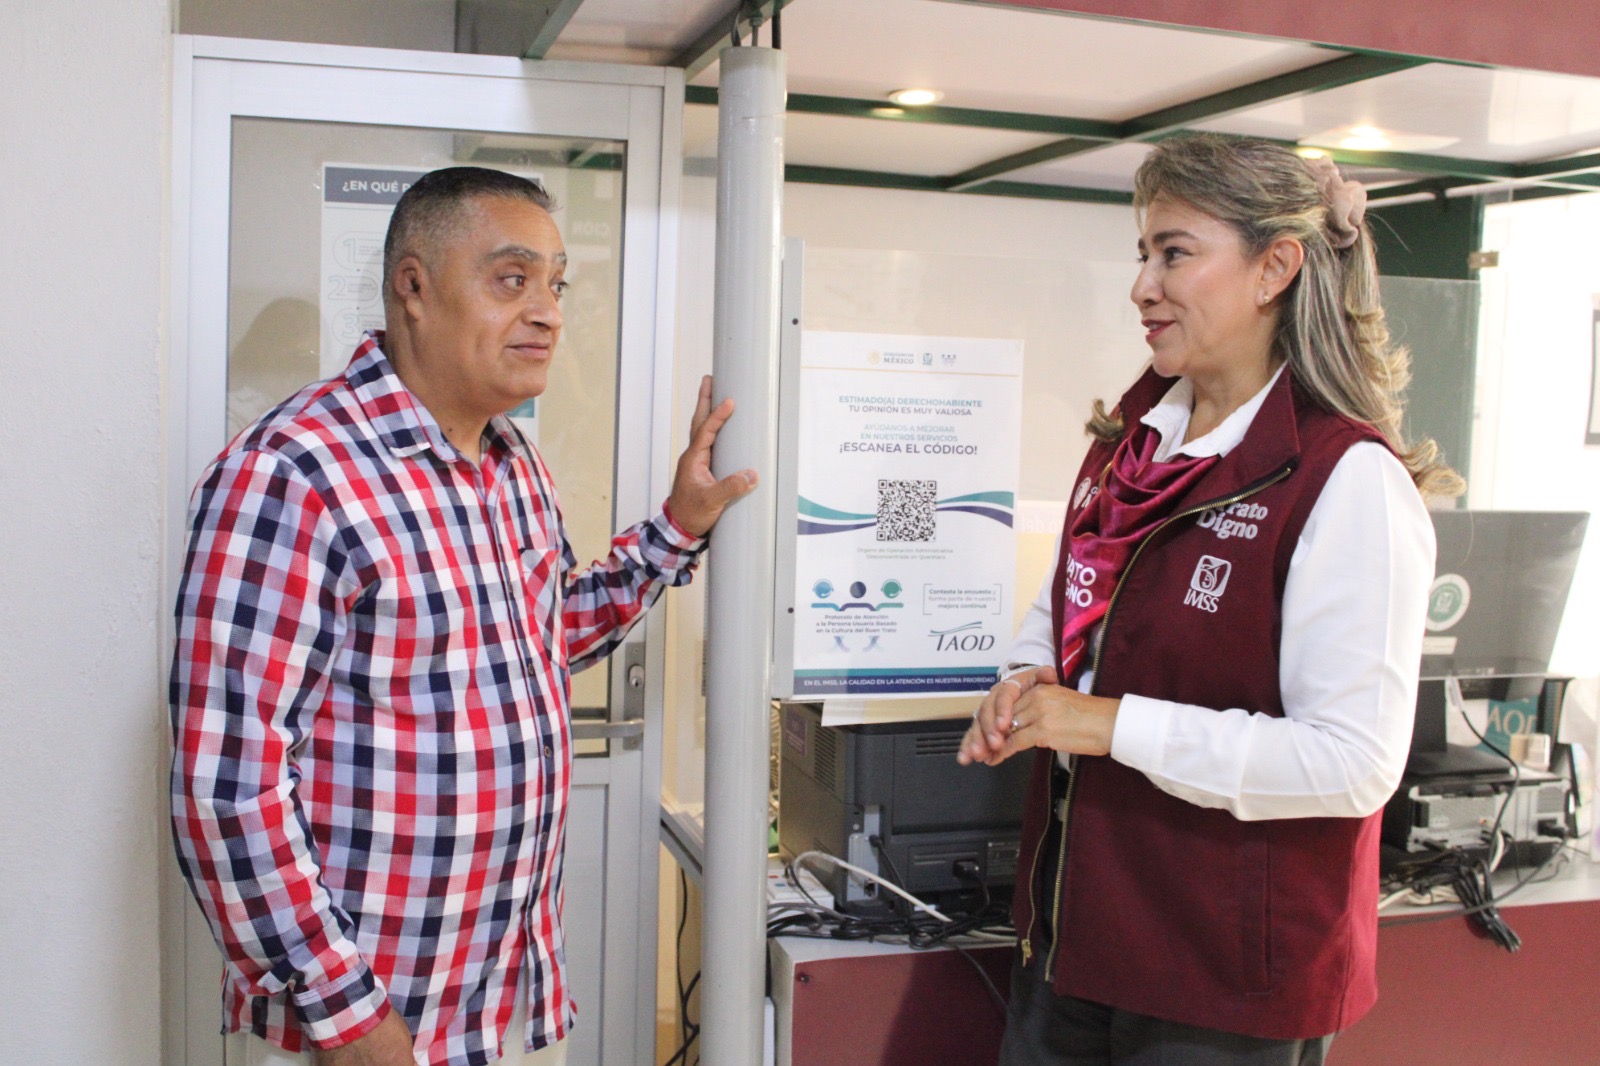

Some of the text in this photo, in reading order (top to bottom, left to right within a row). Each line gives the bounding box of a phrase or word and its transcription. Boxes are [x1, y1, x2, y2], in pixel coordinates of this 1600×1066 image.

[342, 180, 368, 192] ¿EN
[371, 180, 399, 194] QUÉ
[883, 356, 914, 364] MÉXICO
[839, 395, 983, 407] ESTIMADO(A) DERECHOHABIENTE
[849, 405, 860, 413] TU
[862, 405, 898, 413] OPINIÓN
[913, 407, 932, 415] MUY
[935, 408, 972, 416] VALIOSA
[917, 425, 955, 434] MEJORAR
[860, 432, 958, 442] EN NUESTROS SERVICIOS
[839, 442, 978, 455] ¡ESCANEA EL CÓDIGO!
[1196, 509, 1258, 539] Digno
[1183, 588, 1219, 613] IMSS
[930, 633, 995, 651] TAOD
[895, 677, 925, 685] ATENCIÓN
